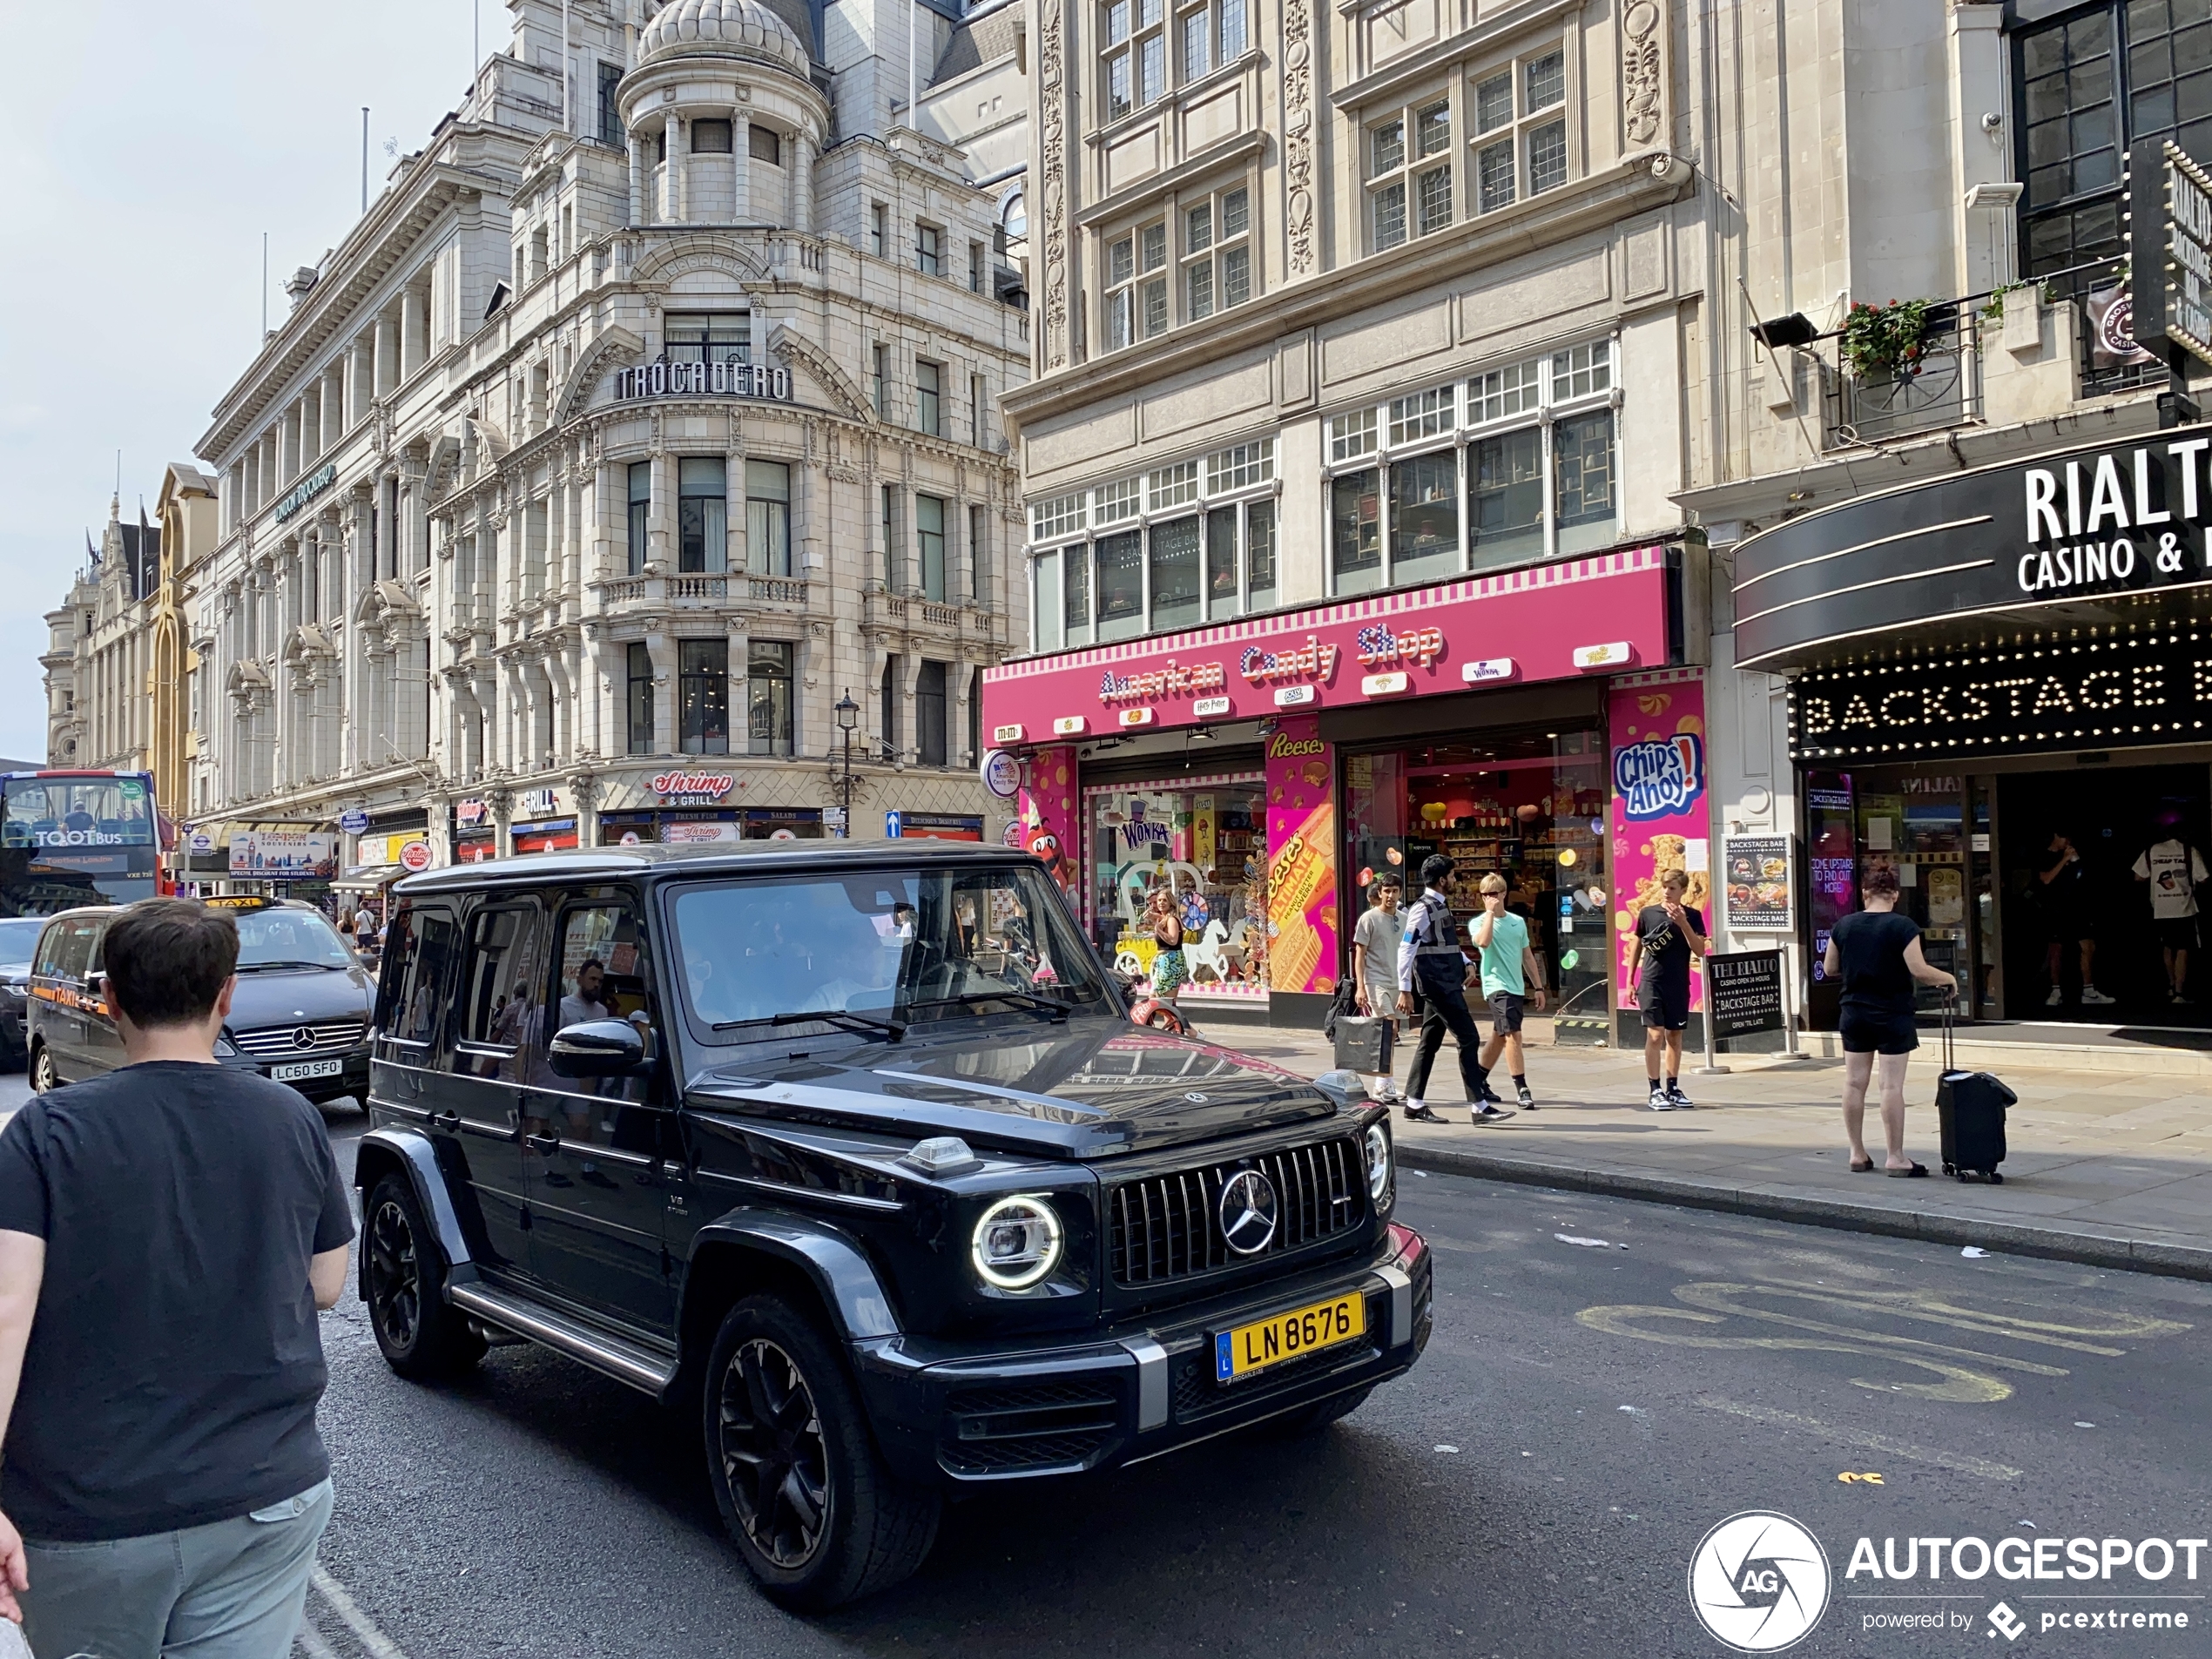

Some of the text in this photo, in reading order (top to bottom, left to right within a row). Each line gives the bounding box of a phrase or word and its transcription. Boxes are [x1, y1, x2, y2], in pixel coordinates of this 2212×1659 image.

[2171, 167, 2210, 246] RIALTO
[2107, 303, 2132, 327] GROSV
[2111, 336, 2138, 347] CASIN
[619, 362, 788, 399] TROCADERO
[2026, 438, 2212, 543] RIALT
[2018, 538, 2134, 591] CASINO
[2156, 532, 2183, 572] &
[1098, 623, 1443, 703] American Candy Shop
[1285, 688, 1301, 698] JOLLY
[1806, 664, 2166, 734] BACKSTAGE
[1620, 746, 1680, 788] Chips
[653, 769, 733, 799] Shrimp
[524, 790, 553, 813] GRILL
[670, 796, 713, 806] & GRILL
[684, 826, 722, 840] Shrimp
[911, 816, 937, 825] DELICIOUS
[1122, 821, 1170, 851] WONKA
[1268, 831, 1304, 908] eese's
[1268, 846, 1314, 921] ULTIMATE
[1284, 870, 1314, 920] PEANUT BUTTER
[1294, 882, 1313, 913] LOVERS
[1712, 958, 1777, 979] THE RIALTO
[55, 987, 76, 1006] TAXI
[1721, 994, 1774, 1010] BACKSTAGE BAR
[276, 1061, 337, 1080] LC60 SFO
[671, 1195, 683, 1204] V8
[1223, 1359, 1229, 1372] L
